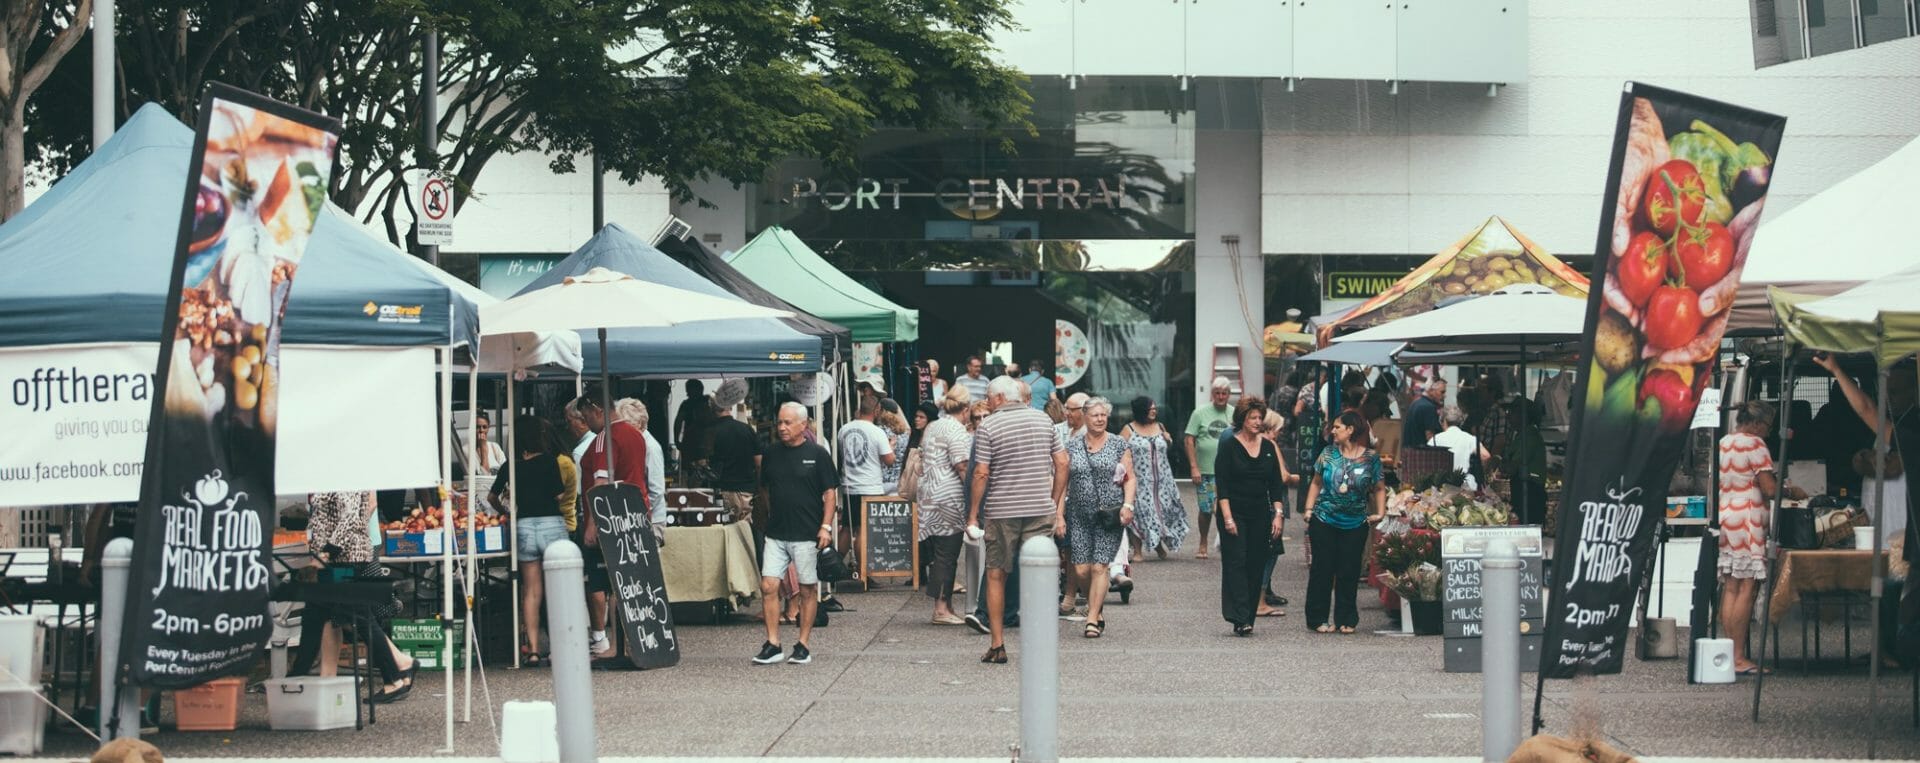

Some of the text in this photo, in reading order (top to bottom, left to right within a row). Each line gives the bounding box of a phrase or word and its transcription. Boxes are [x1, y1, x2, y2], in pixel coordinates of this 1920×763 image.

[793, 175, 1127, 211] PORT CENTRAL
[507, 259, 523, 276] It's
[13, 366, 156, 412] offthera
[55, 416, 99, 440] giving
[103, 418, 128, 437] you
[162, 502, 262, 551] REAL FOOD
[153, 544, 269, 598] MARKETS
[1446, 559, 1482, 573] TASTIN
[1447, 573, 1480, 587] SALES
[1446, 587, 1482, 602] CHEES
[152, 608, 199, 635] 2pm
[214, 613, 264, 636] 6pm
[1564, 602, 1605, 628] 2pm
[393, 625, 441, 633] FRESH FRUIT
[147, 645, 179, 660] Every
[182, 648, 225, 662] Tuesday
[229, 645, 239, 655] in
[1562, 639, 1587, 654] Every
[145, 660, 167, 673] Port
[168, 662, 207, 675] Central
